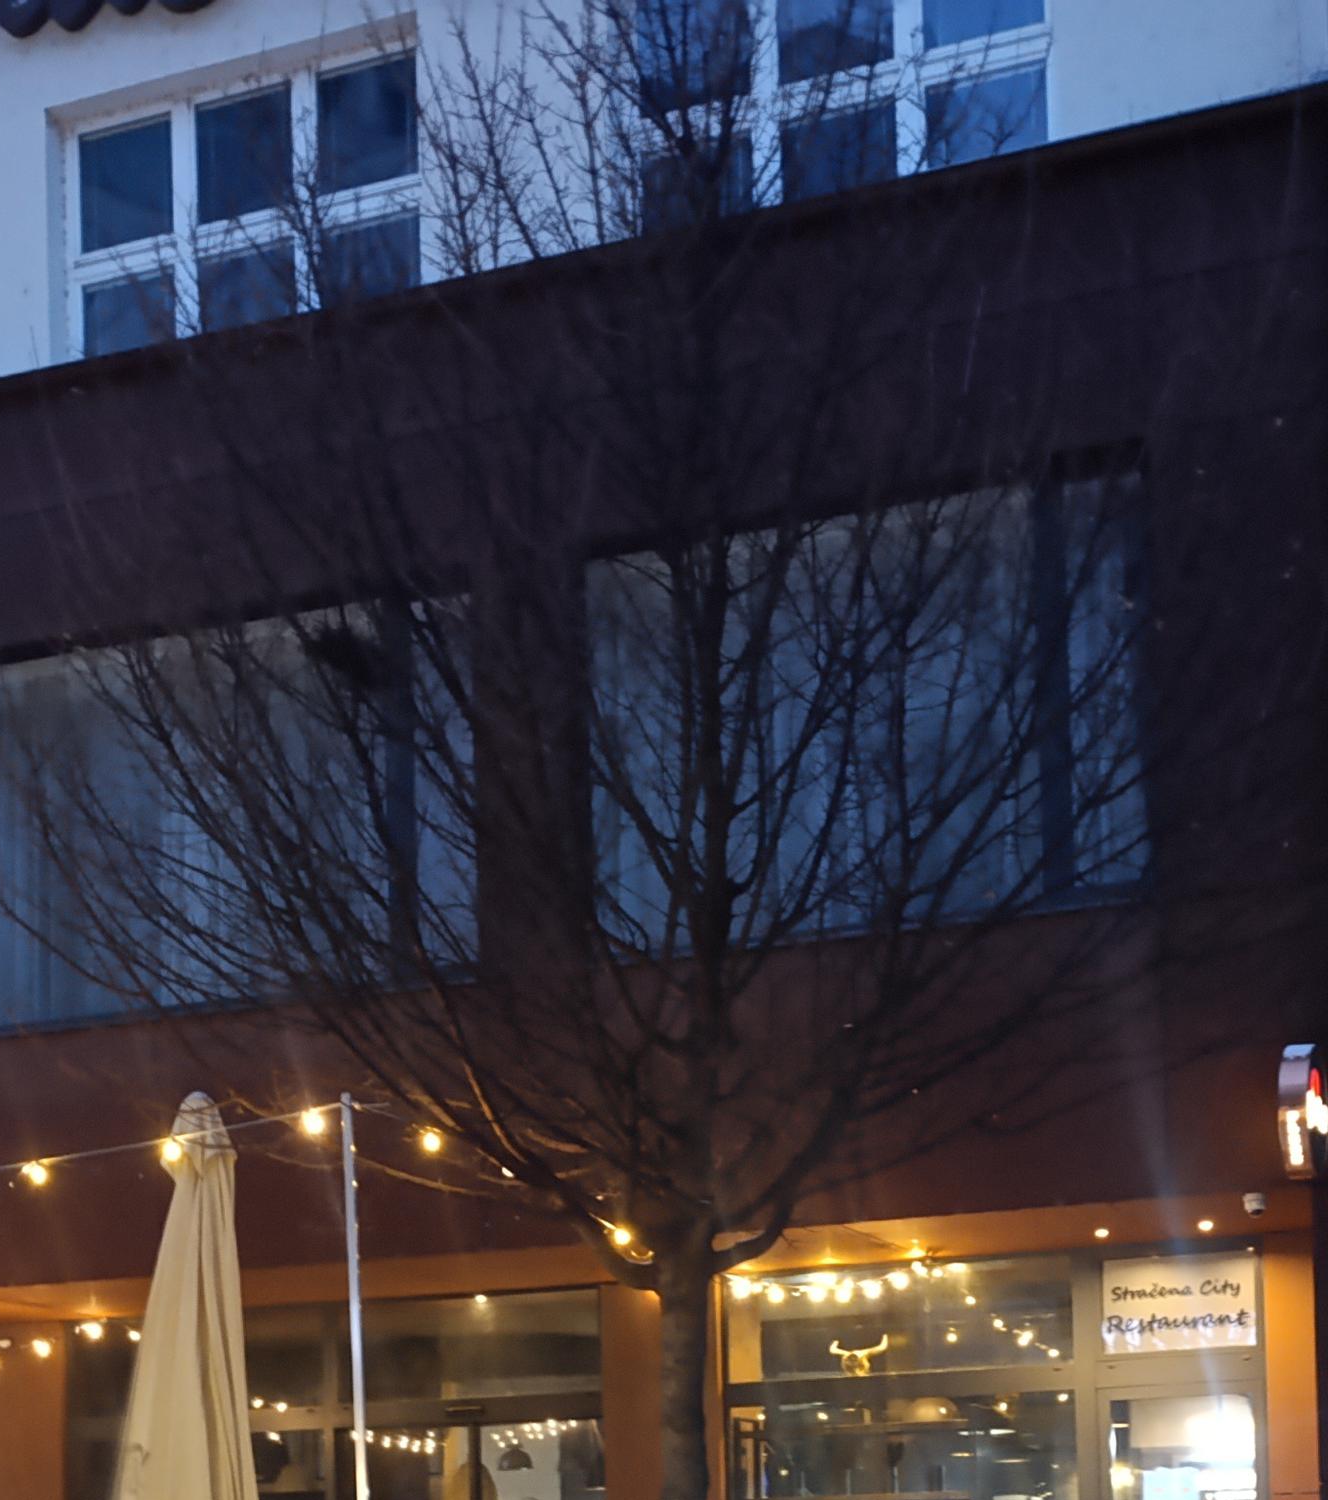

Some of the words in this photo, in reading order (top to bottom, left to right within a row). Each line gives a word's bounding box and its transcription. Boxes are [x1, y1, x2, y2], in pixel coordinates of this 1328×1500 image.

[1110, 1281, 1193, 1302] Stračena
[1199, 1278, 1241, 1297] City
[1106, 1308, 1251, 1335] Restaurant
